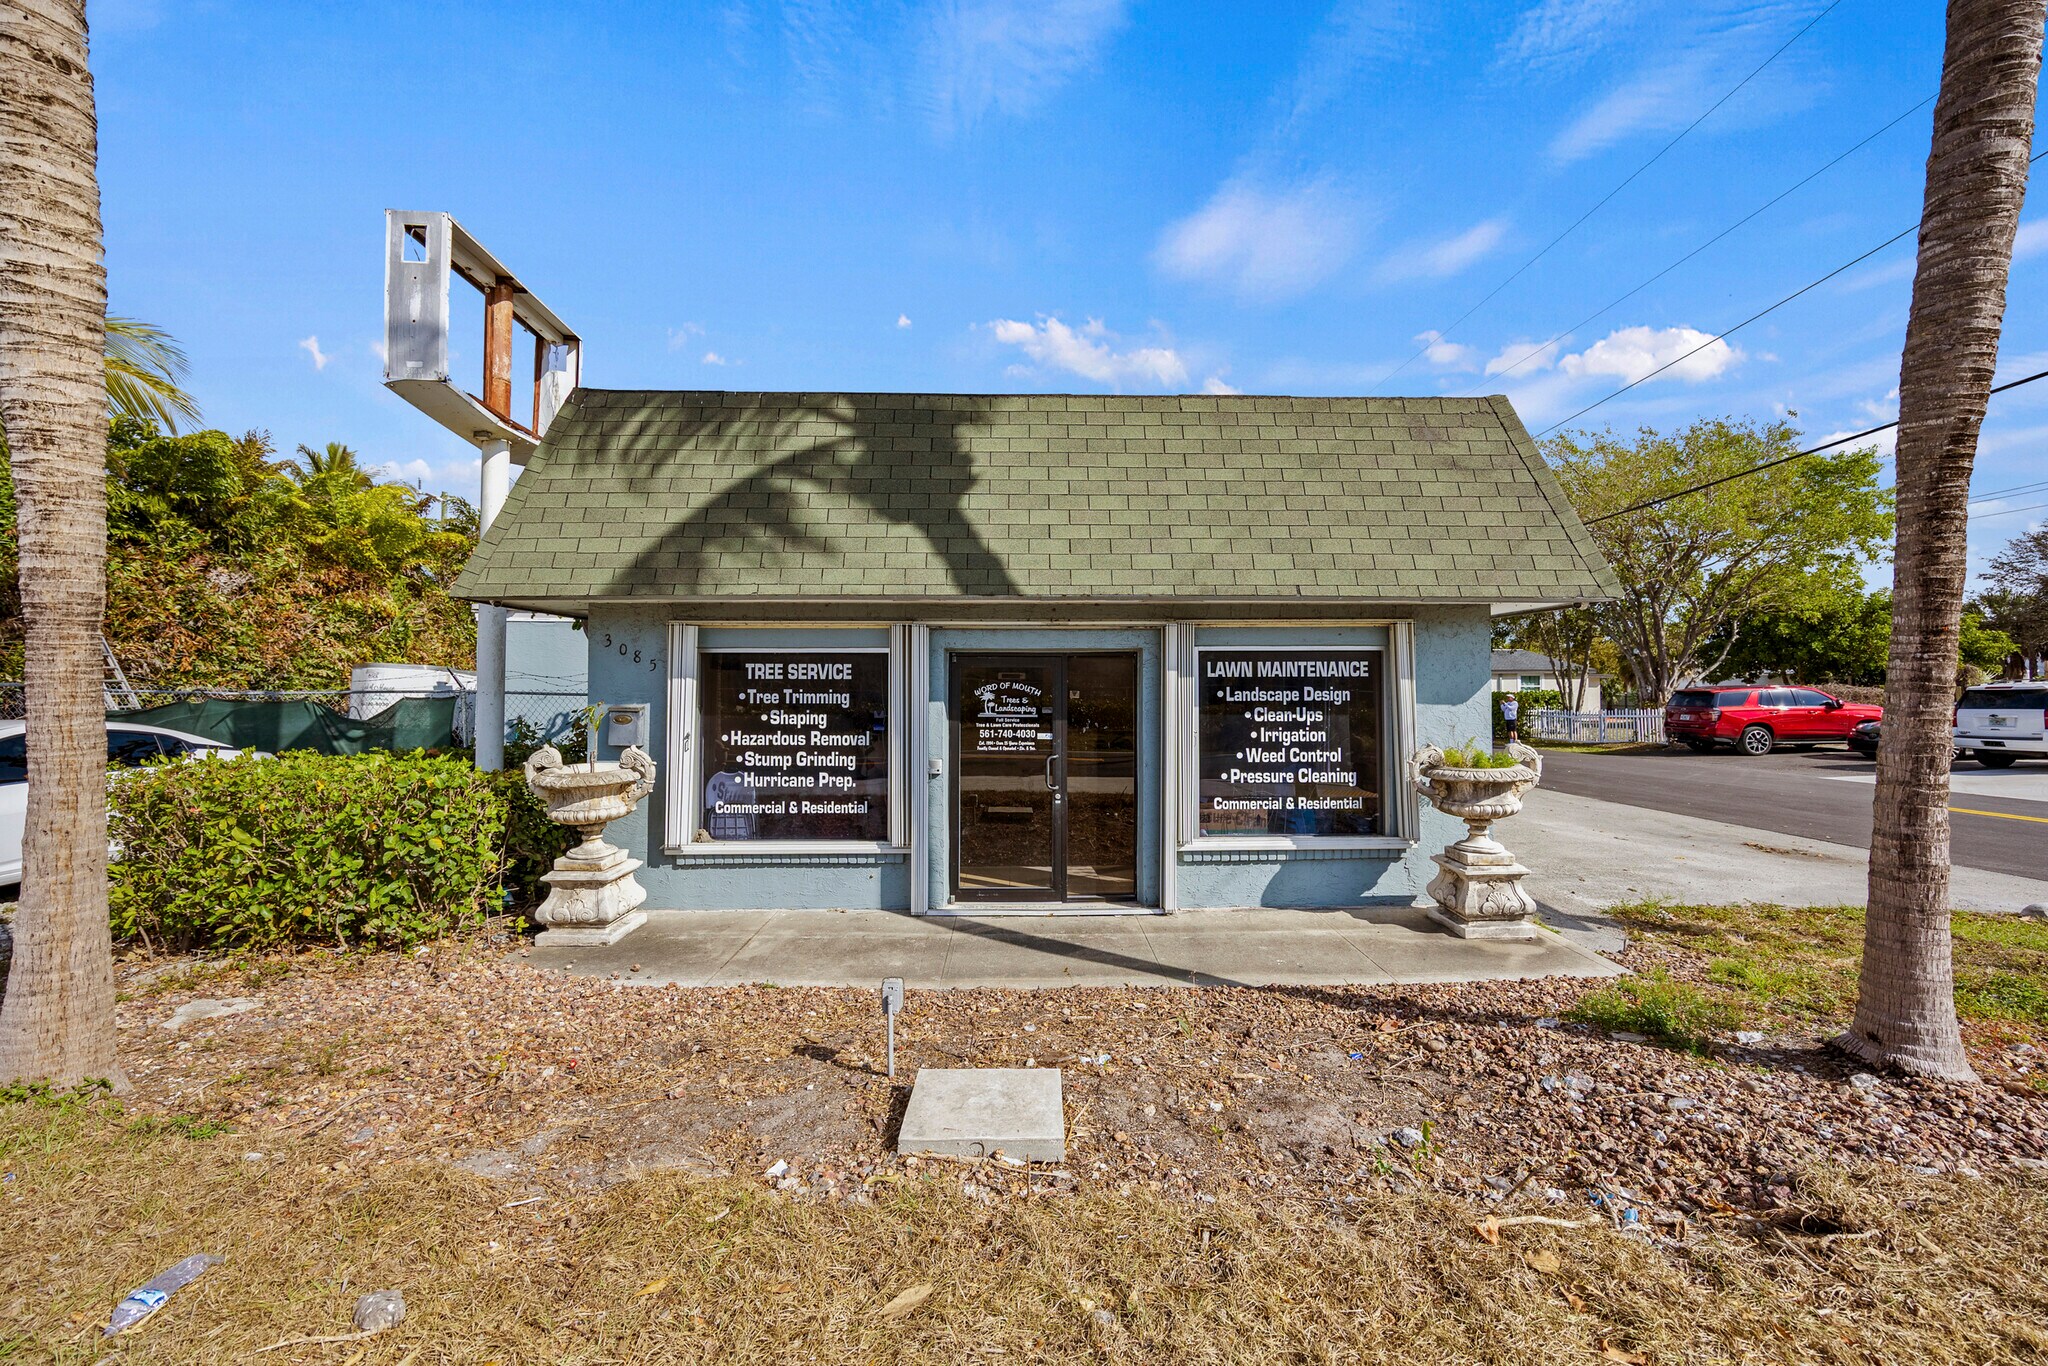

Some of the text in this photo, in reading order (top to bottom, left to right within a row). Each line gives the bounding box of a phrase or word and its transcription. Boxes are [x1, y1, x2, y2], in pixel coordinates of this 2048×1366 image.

[604, 633, 657, 672] 3085
[745, 664, 852, 679] TREE SERVICE
[1207, 661, 1369, 677] LAWN MAINTENANCE
[974, 684, 997, 695] WORD
[1012, 683, 1041, 696] MOUTH
[1226, 687, 1350, 705] Landscape Design
[748, 689, 849, 708] Tree Trimming
[995, 704, 1036, 714] Landscaping
[1254, 707, 1323, 725] Clean-Ups
[770, 710, 827, 728] Shaping
[731, 731, 869, 745] Hazardous Removal
[980, 730, 1035, 738] 561-740-4030
[1261, 727, 1326, 745] Irrigation
[745, 752, 856, 770] Stump Grinding
[1246, 748, 1341, 762] Weed Control
[744, 772, 856, 791] Hurricane Prep.
[1231, 768, 1356, 786] Pressure Cleaning
[715, 801, 868, 813] Commercial & Residential
[1214, 797, 1362, 810] Commercial & Residential
